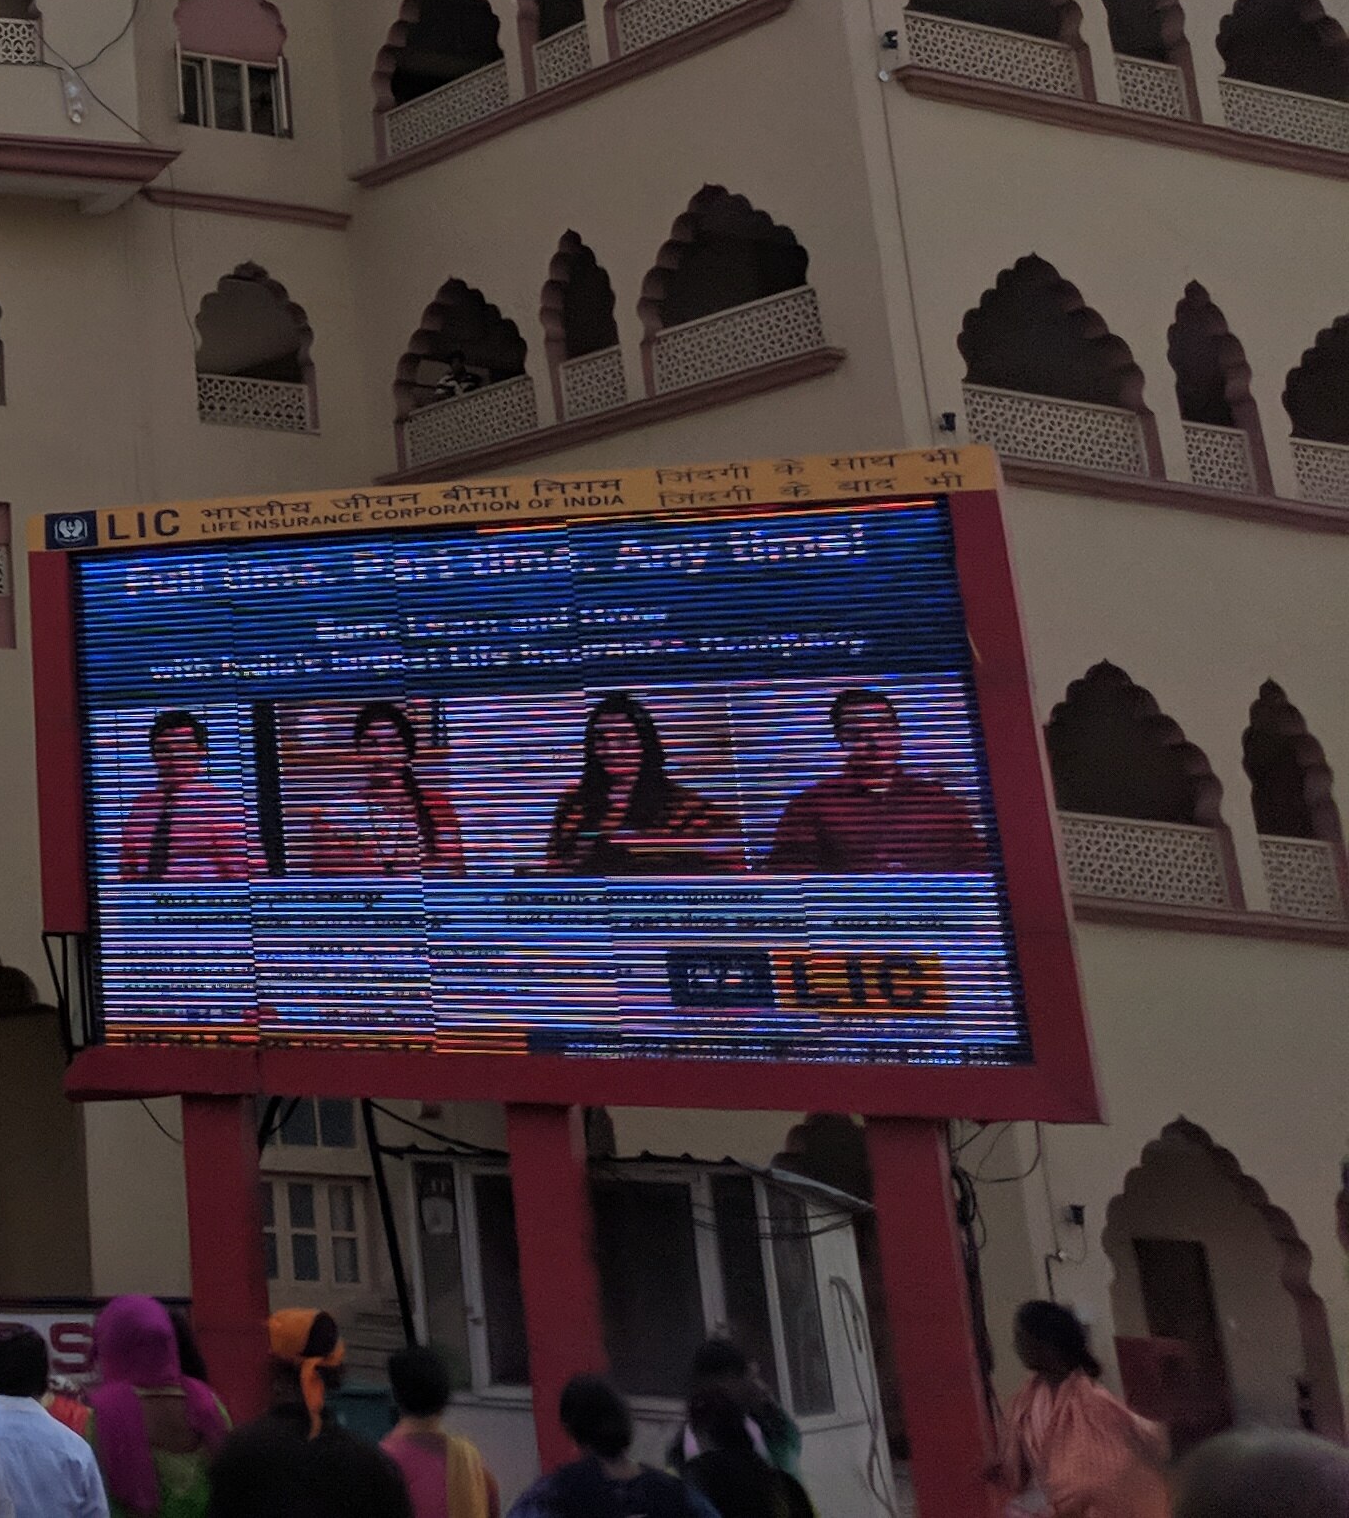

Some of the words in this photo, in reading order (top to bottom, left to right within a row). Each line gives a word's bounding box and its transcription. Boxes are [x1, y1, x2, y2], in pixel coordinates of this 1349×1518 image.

[830, 453, 898, 469] साथ
[922, 448, 961, 465] भी
[202, 499, 312, 521] भारतीय
[331, 492, 420, 511] जीवन
[441, 485, 511, 502] बीमा
[534, 478, 623, 497] निगम
[838, 477, 899, 492] बाद
[108, 509, 180, 540] LIC
[202, 520, 241, 533] LIFE
[248, 510, 364, 530] INSURANCE
[371, 500, 520, 522] CORPORATION
[527, 498, 556, 510] OF
[564, 494, 624, 508] INDIA
[125, 561, 204, 597] Full
[353, 545, 456, 584] Part
[613, 537, 710, 576] Any
[790, 954, 927, 1008] LIC
